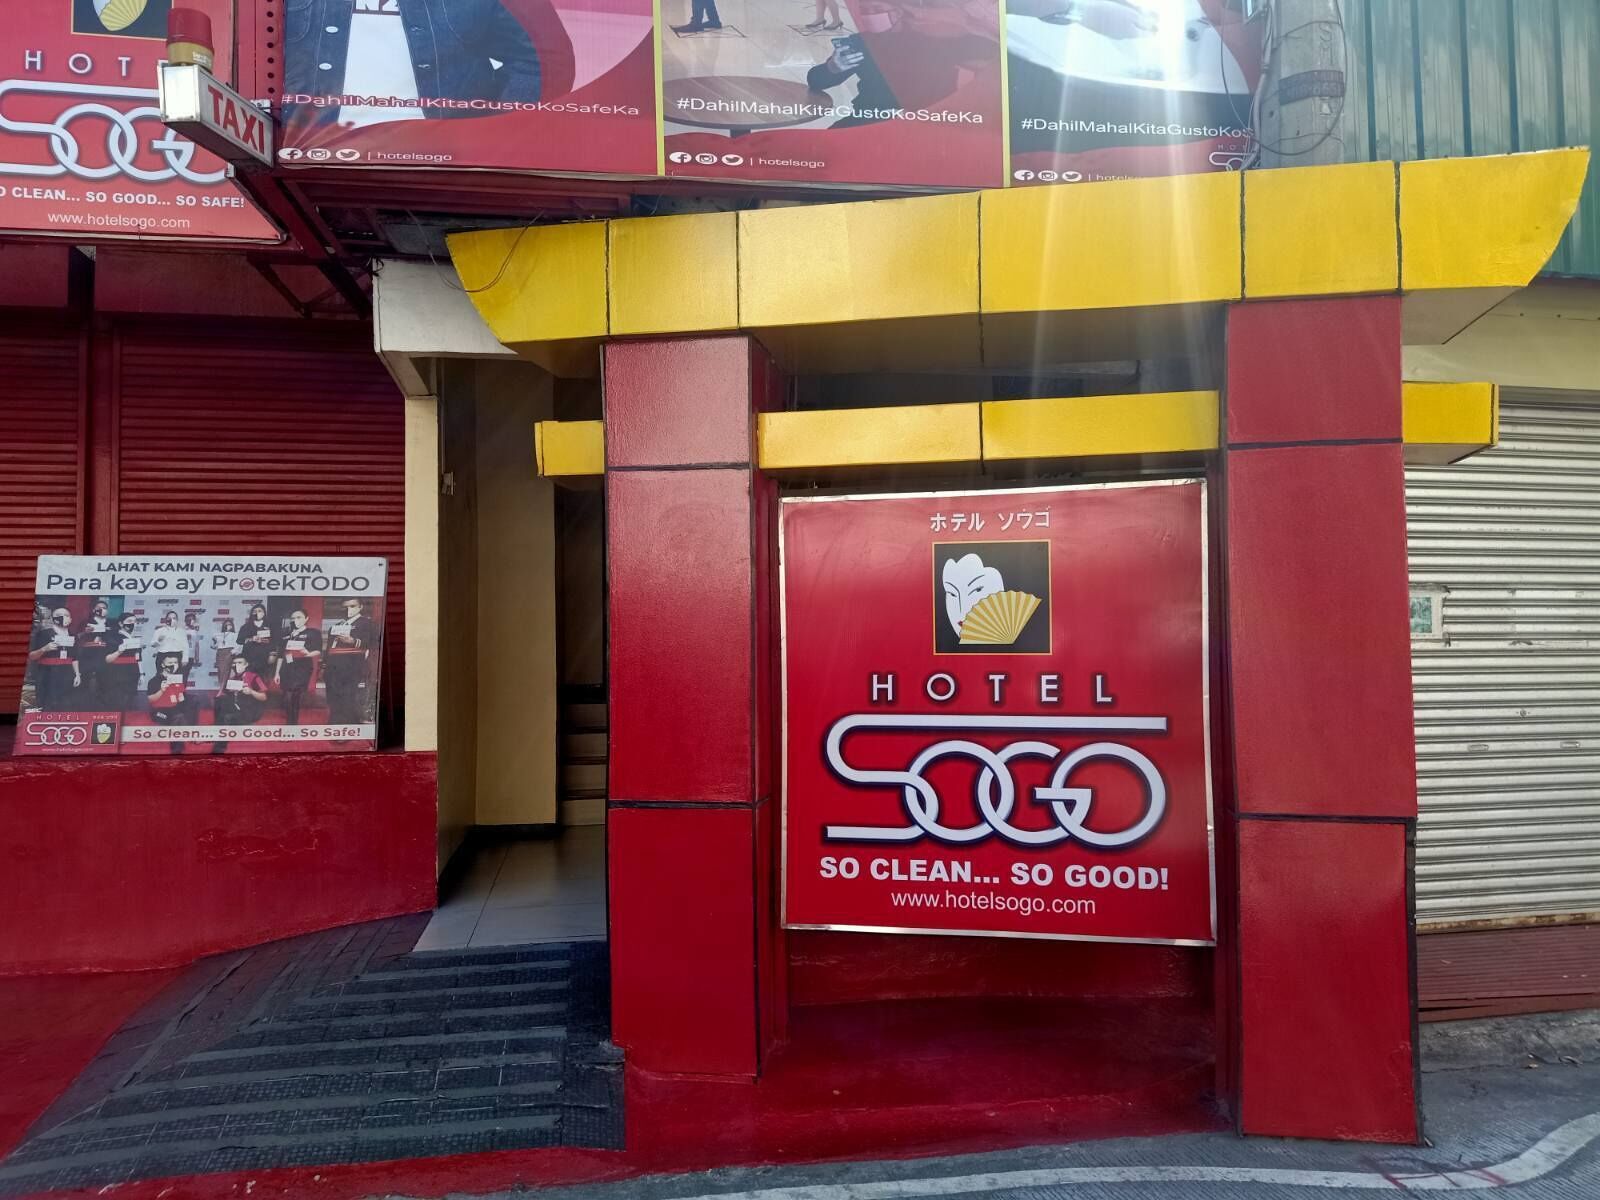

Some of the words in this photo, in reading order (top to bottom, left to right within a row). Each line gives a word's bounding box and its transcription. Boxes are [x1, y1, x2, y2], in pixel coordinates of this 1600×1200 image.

[24, 49, 168, 78] HOT
[281, 93, 640, 117] #DahilMahalKitaGustoKoSafeKa
[676, 97, 984, 124] #DahilMahalKitaGustoKoSafeKa
[207, 84, 266, 155] TAXI
[377, 151, 453, 162] hotelsogo
[758, 157, 826, 169] hotelsogo
[12, 187, 80, 202] CLEAN...
[86, 192, 107, 203] SO
[113, 193, 170, 206] GOOD...
[176, 195, 197, 207] SO
[201, 196, 245, 208] SAFE!
[47, 212, 191, 230] www.hotelsogo.com
[930, 511, 985, 533] ホテル
[998, 506, 1052, 531] ソウゴ
[97, 562, 150, 573] LAHAT
[154, 562, 195, 573] KAMI
[199, 562, 323, 574] NAGPABAKUNA
[46, 575, 102, 591] Para
[110, 574, 168, 594] kayo
[175, 578, 205, 594] ay
[872, 672, 1113, 703] HOTEL
[25, 721, 89, 746] SOGO
[133, 727, 152, 740] So
[157, 727, 214, 740] Clean...
[218, 727, 238, 739] So
[242, 727, 295, 739] Good...
[300, 726, 319, 739] So
[323, 725, 361, 739] Safe!
[824, 713, 1168, 848] SOGO
[820, 857, 860, 879] SO
[870, 858, 999, 884] CLEAN...
[1011, 863, 1054, 886] SO
[1065, 865, 1169, 891] GOOD!
[891, 891, 1096, 916] www.hotelsogo.com
